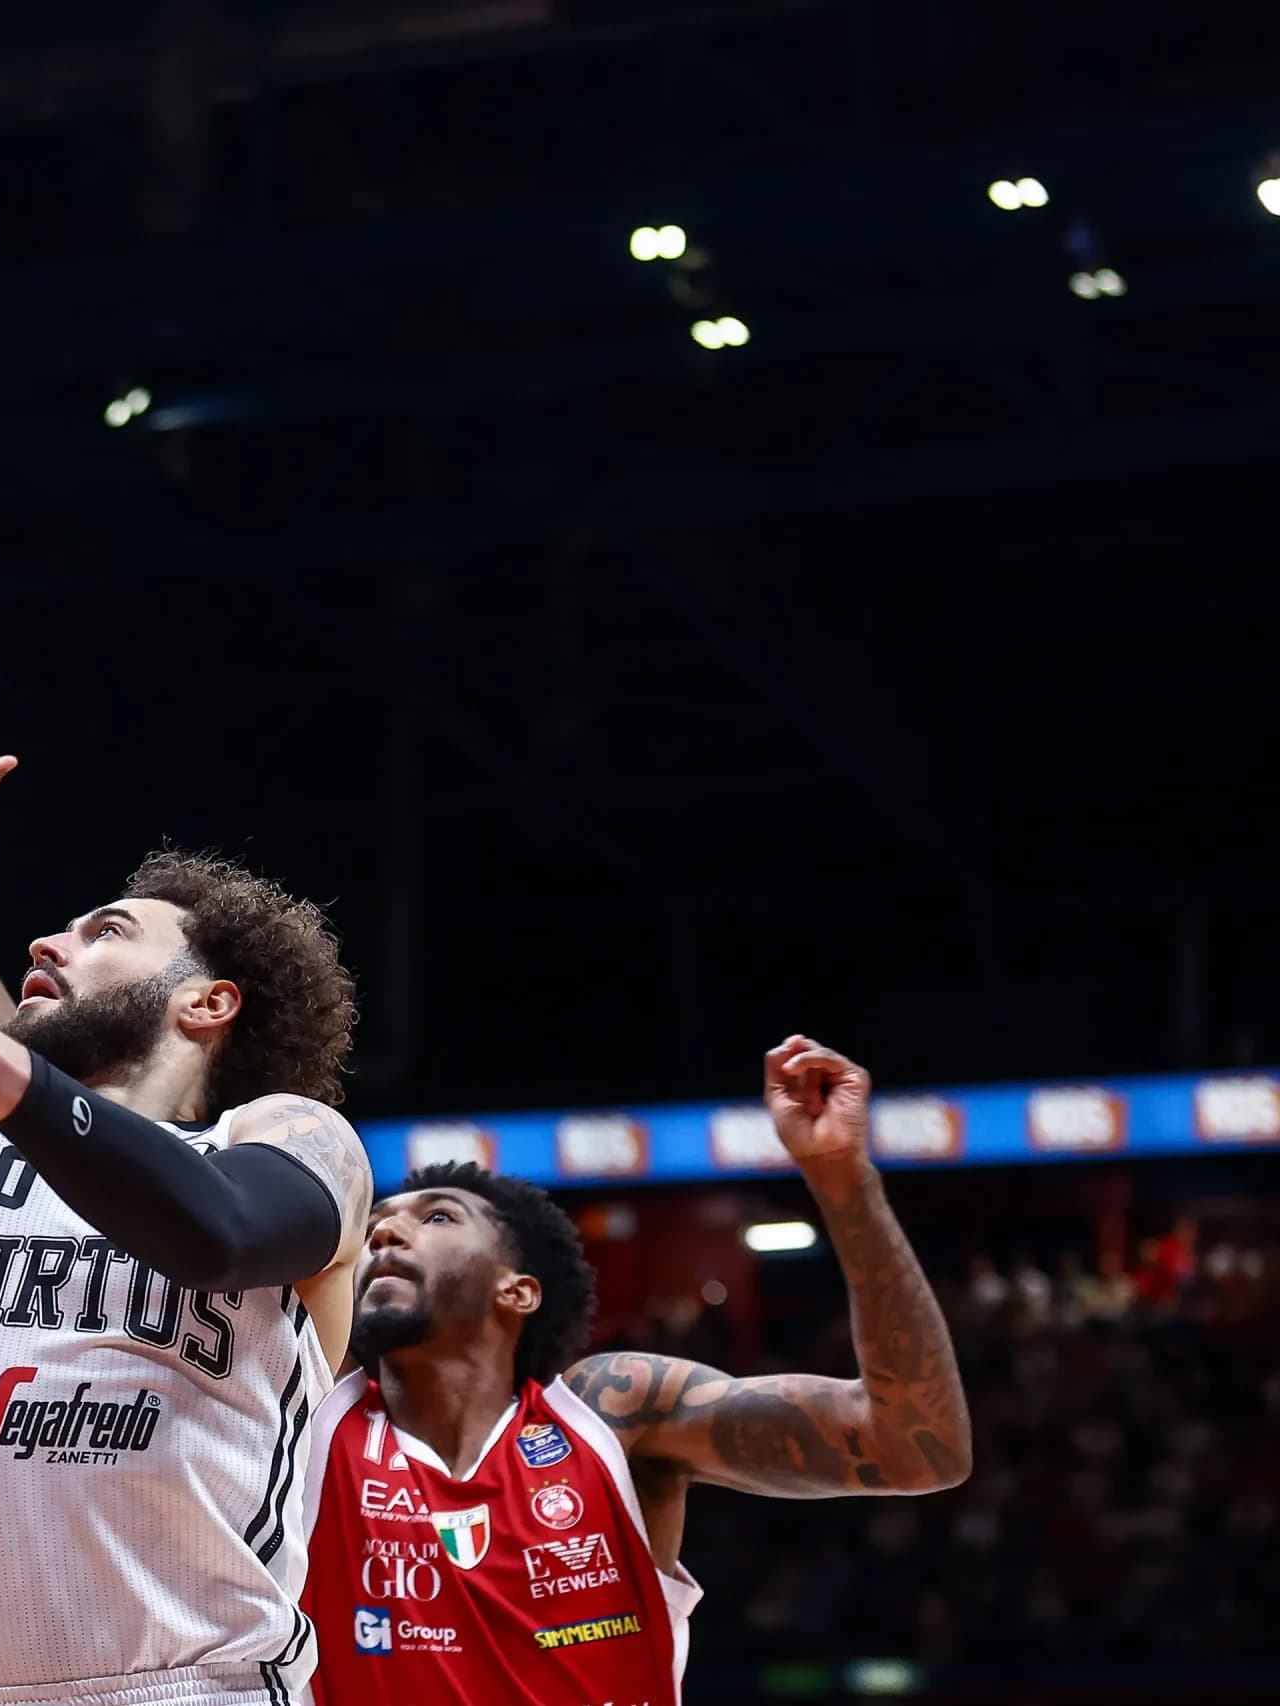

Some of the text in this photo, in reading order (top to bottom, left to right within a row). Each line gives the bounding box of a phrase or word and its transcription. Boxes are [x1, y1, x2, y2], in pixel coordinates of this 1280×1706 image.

[46, 1450, 118, 1466] ZANETTI
[530, 1567, 621, 1599] EYEWEAR
[355, 1610, 457, 1650] Gi Group
[534, 1616, 641, 1649] SIMMENTHAL
